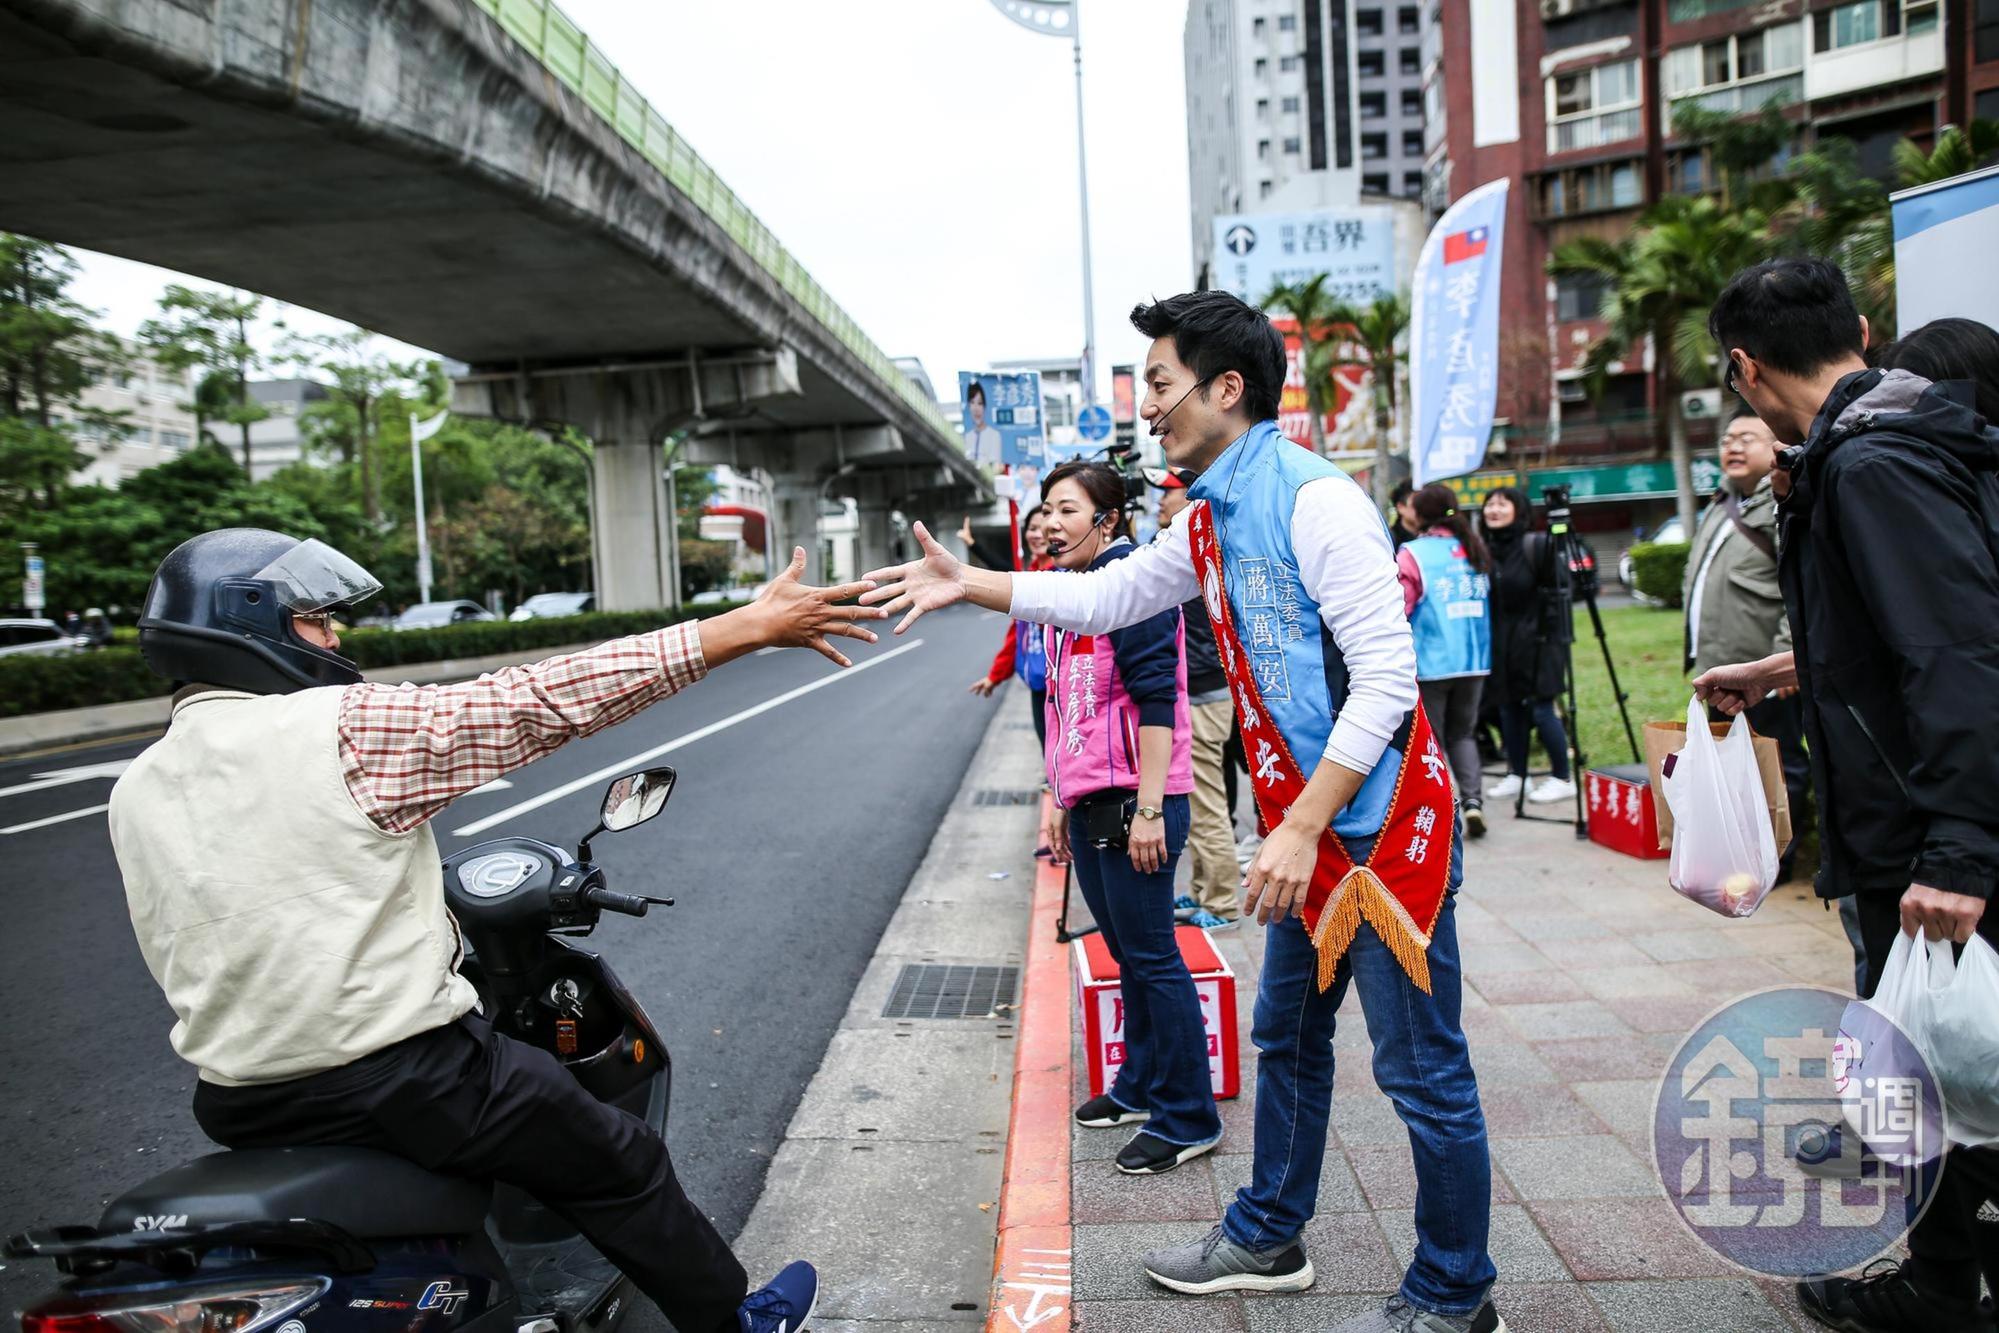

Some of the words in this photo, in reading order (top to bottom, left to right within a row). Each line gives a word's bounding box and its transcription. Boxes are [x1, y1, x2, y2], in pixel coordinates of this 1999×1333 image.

[1246, 566, 1282, 693] 蔣萬安
[1274, 561, 1304, 643] 立法委員
[1081, 655, 1097, 719] 立法委員
[1405, 805, 1436, 865] 鞠躬
[133, 1214, 189, 1232] SYM
[349, 1299, 374, 1308] 125
[417, 1281, 469, 1315] GT
